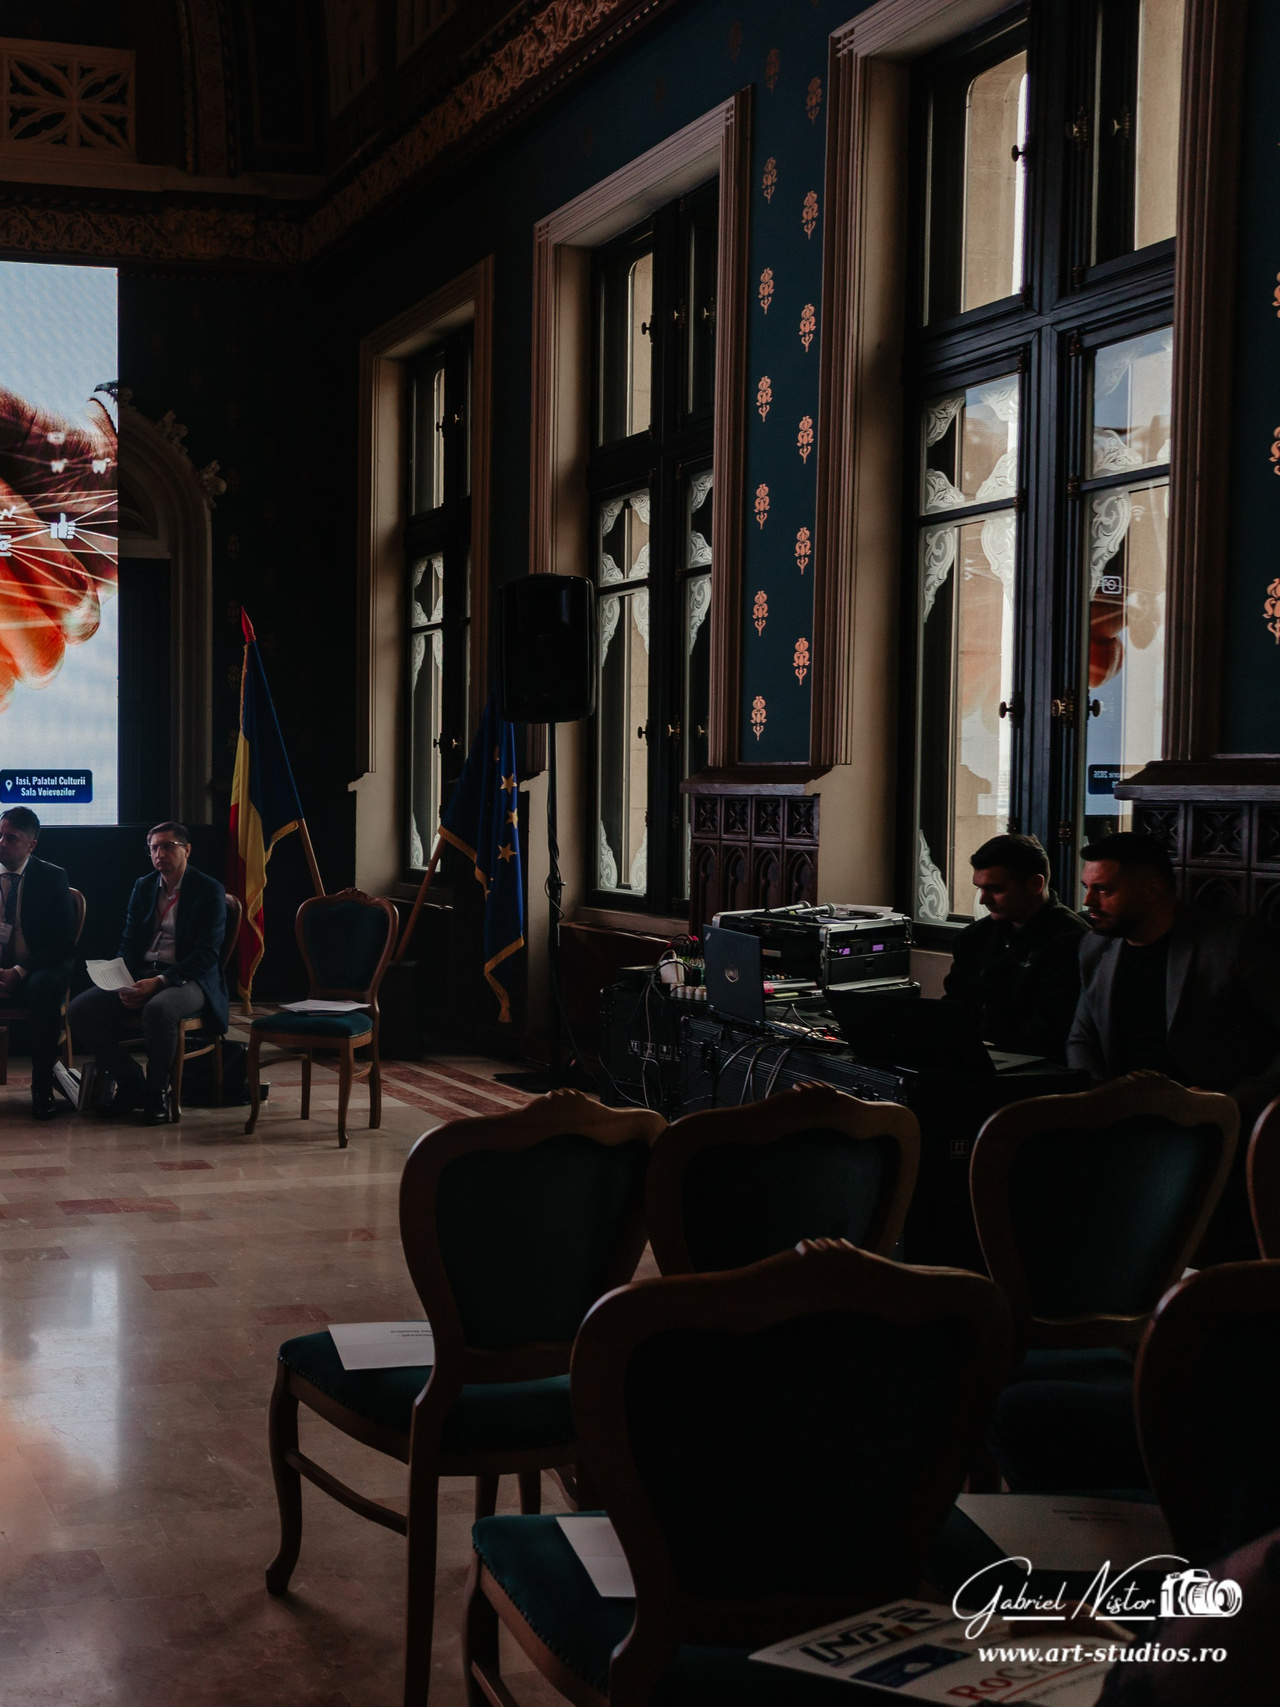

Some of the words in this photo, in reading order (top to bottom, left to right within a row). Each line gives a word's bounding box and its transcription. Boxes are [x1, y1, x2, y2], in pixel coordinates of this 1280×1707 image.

[32, 776, 58, 786] Palatul
[58, 776, 86, 786] Culturii
[20, 788, 36, 796] Sala
[38, 788, 76, 796] Voievozilor
